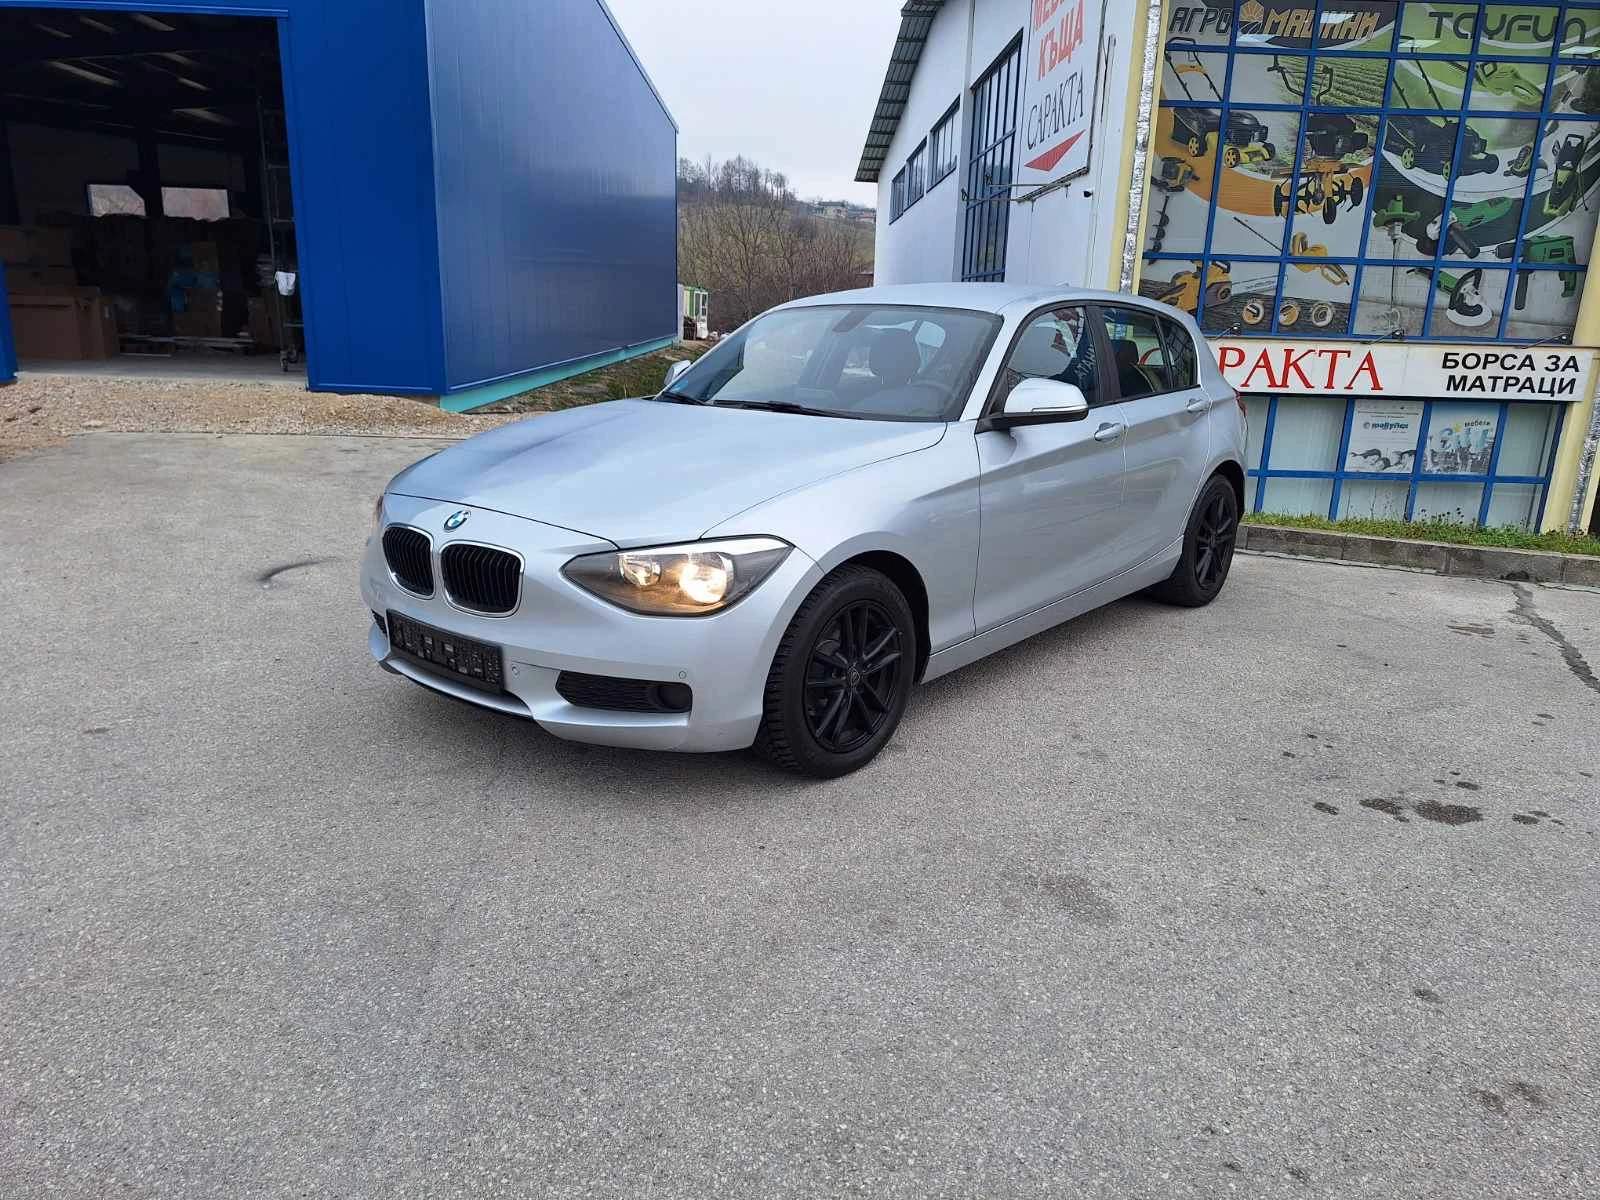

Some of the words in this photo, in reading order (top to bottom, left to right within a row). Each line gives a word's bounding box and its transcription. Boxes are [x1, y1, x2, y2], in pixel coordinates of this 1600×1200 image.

[1168, 6, 1233, 35] АГРО
[1038, 0, 1085, 81] КЪЩА
[1027, 66, 1084, 150] САРАКТА
[1441, 352, 1536, 371] БОРСА
[1544, 354, 1580, 372] ЗА
[1446, 375, 1577, 397] МАТРАЦИ
